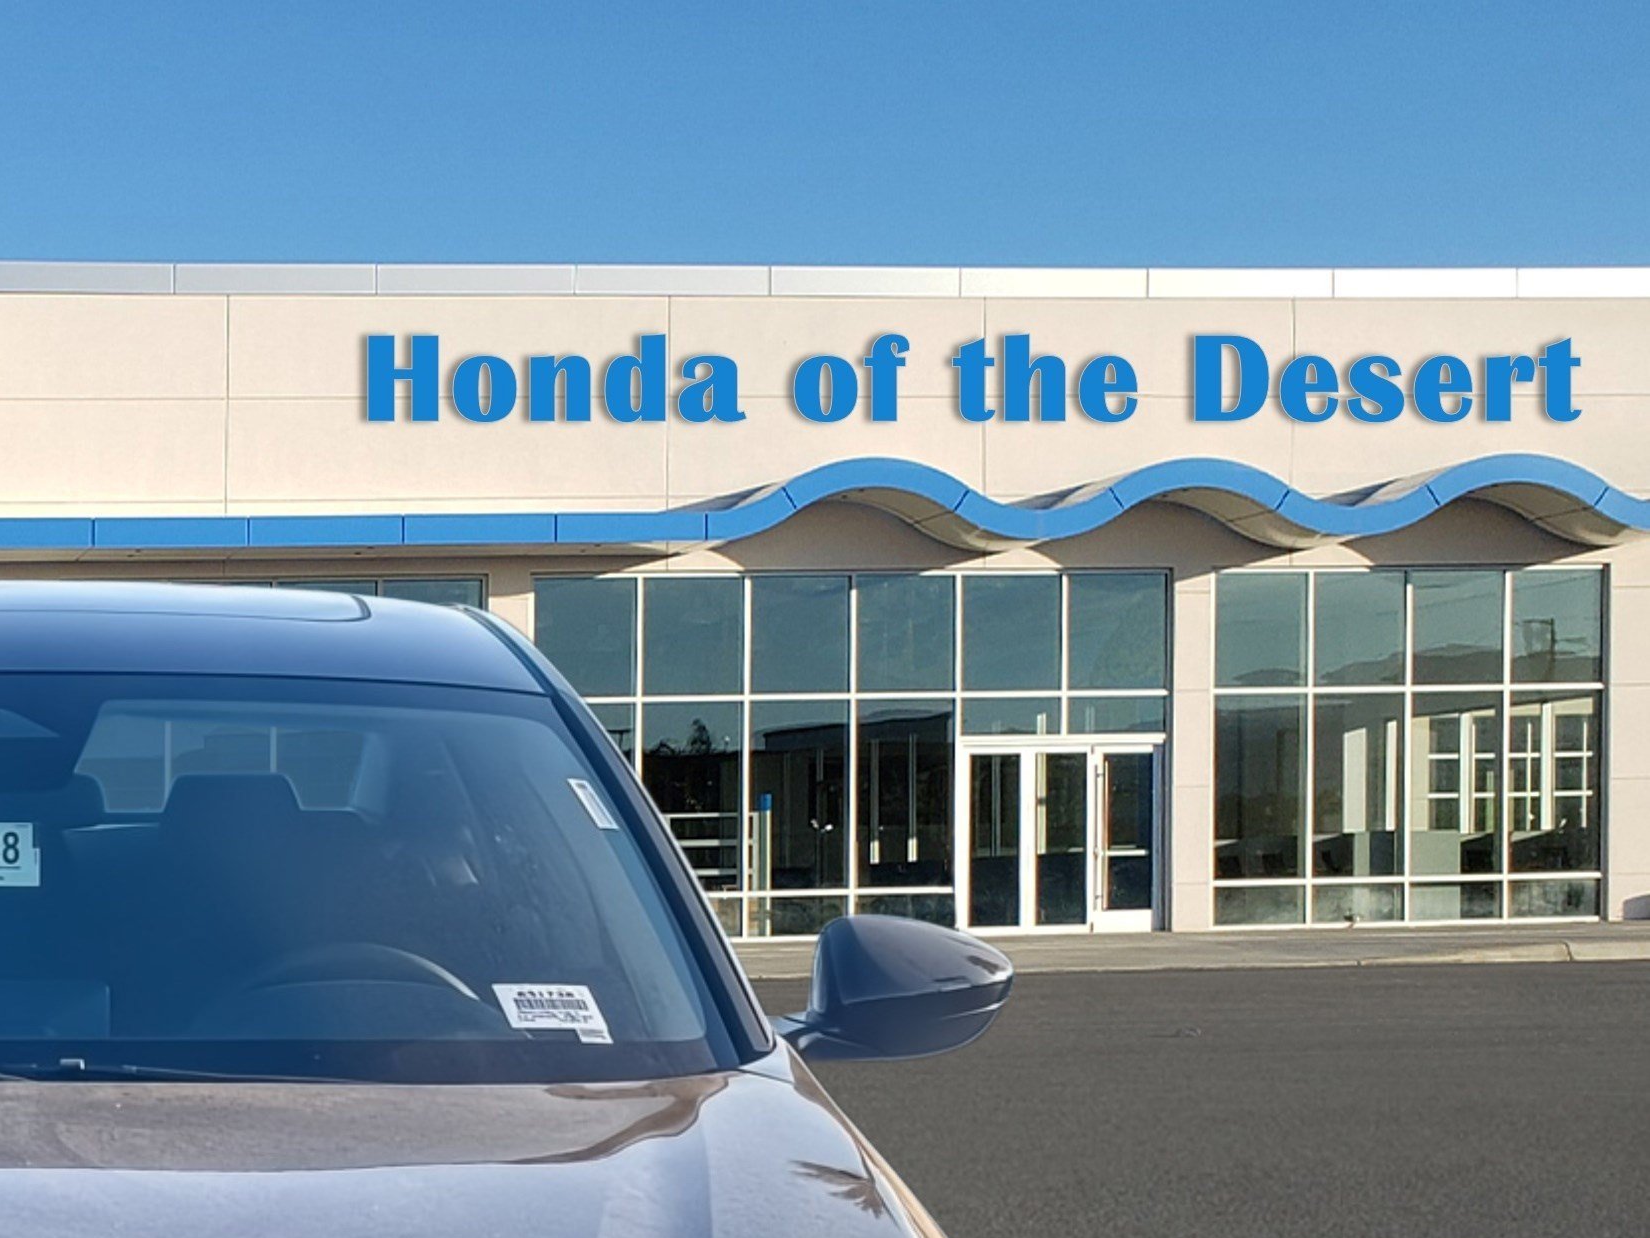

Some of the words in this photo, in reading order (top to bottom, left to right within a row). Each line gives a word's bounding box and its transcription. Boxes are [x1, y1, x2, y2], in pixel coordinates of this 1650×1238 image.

[366, 333, 747, 424] Honda
[793, 333, 910, 424] of
[952, 334, 1139, 424] the
[1193, 334, 1582, 424] Desert
